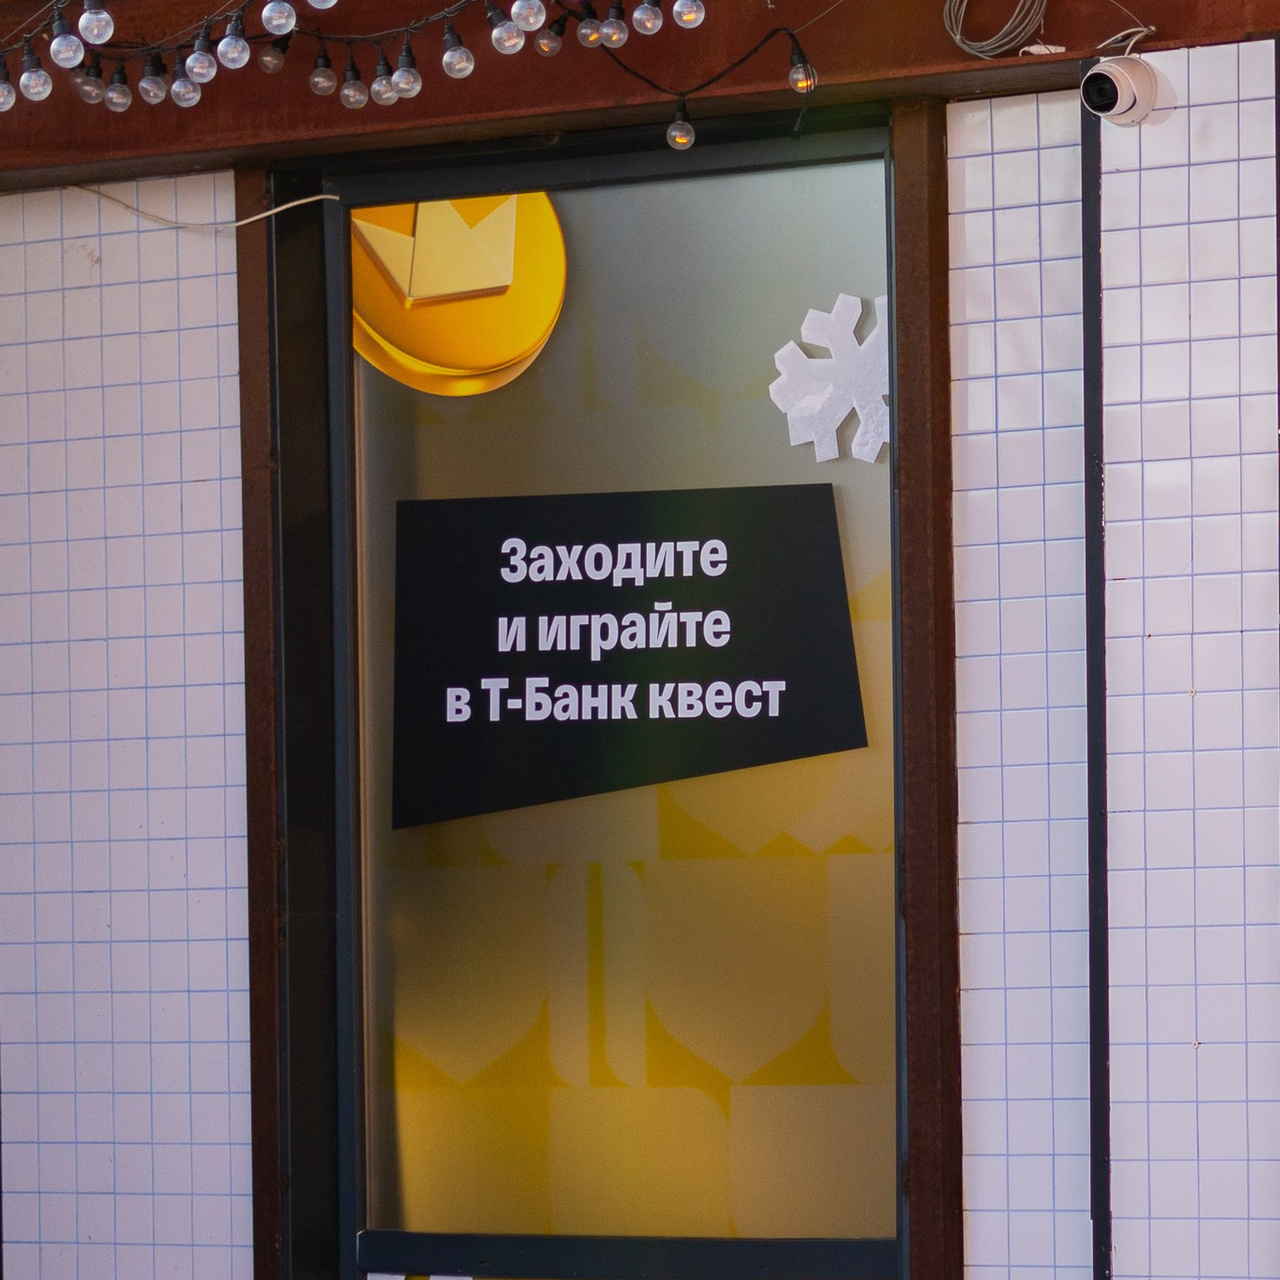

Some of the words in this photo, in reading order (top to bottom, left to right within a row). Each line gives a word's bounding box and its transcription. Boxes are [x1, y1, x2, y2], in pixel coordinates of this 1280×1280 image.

[500, 537, 728, 587] Заходите
[497, 616, 526, 652] и
[537, 601, 731, 661] играйте
[445, 687, 471, 723] в
[480, 677, 638, 722] Т-Банк
[648, 680, 786, 719] квест
